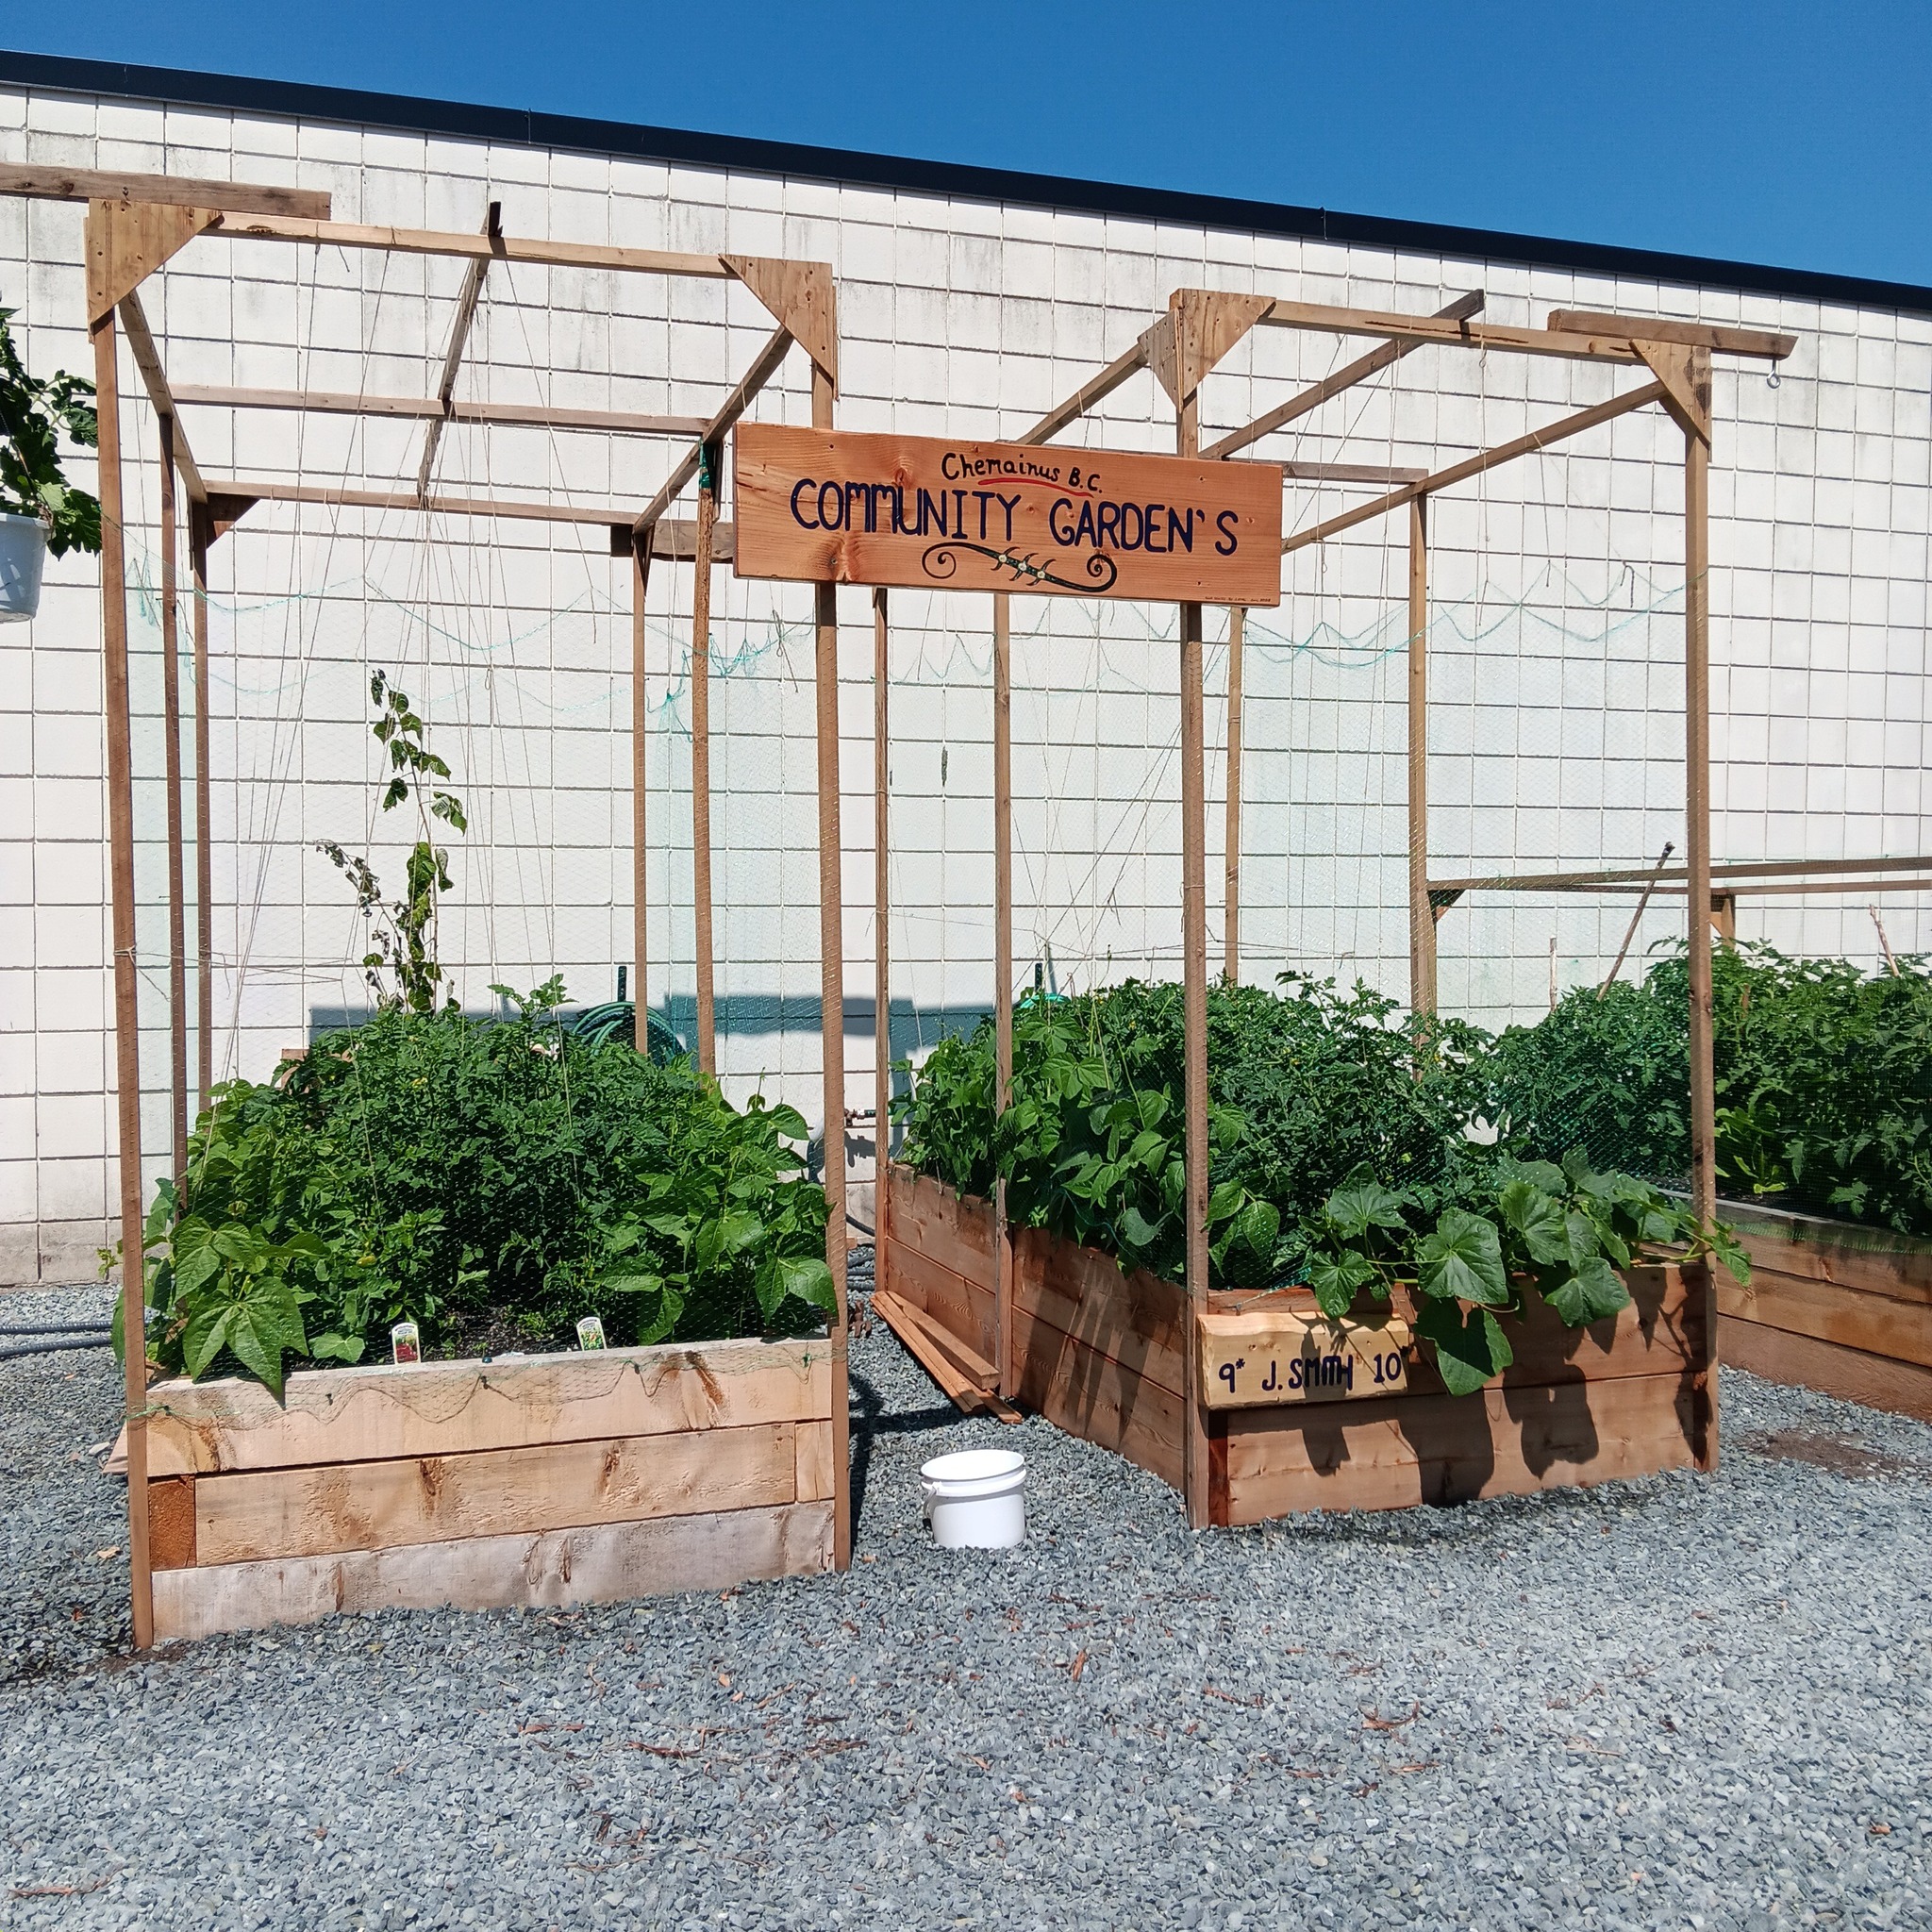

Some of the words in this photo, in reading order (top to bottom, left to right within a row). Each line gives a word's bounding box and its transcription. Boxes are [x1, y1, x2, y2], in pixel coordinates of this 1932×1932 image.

[941, 453, 1060, 482] Chemainus
[791, 478, 1022, 541] COMMUNITY
[1049, 497, 1239, 556] GARDEN'S
